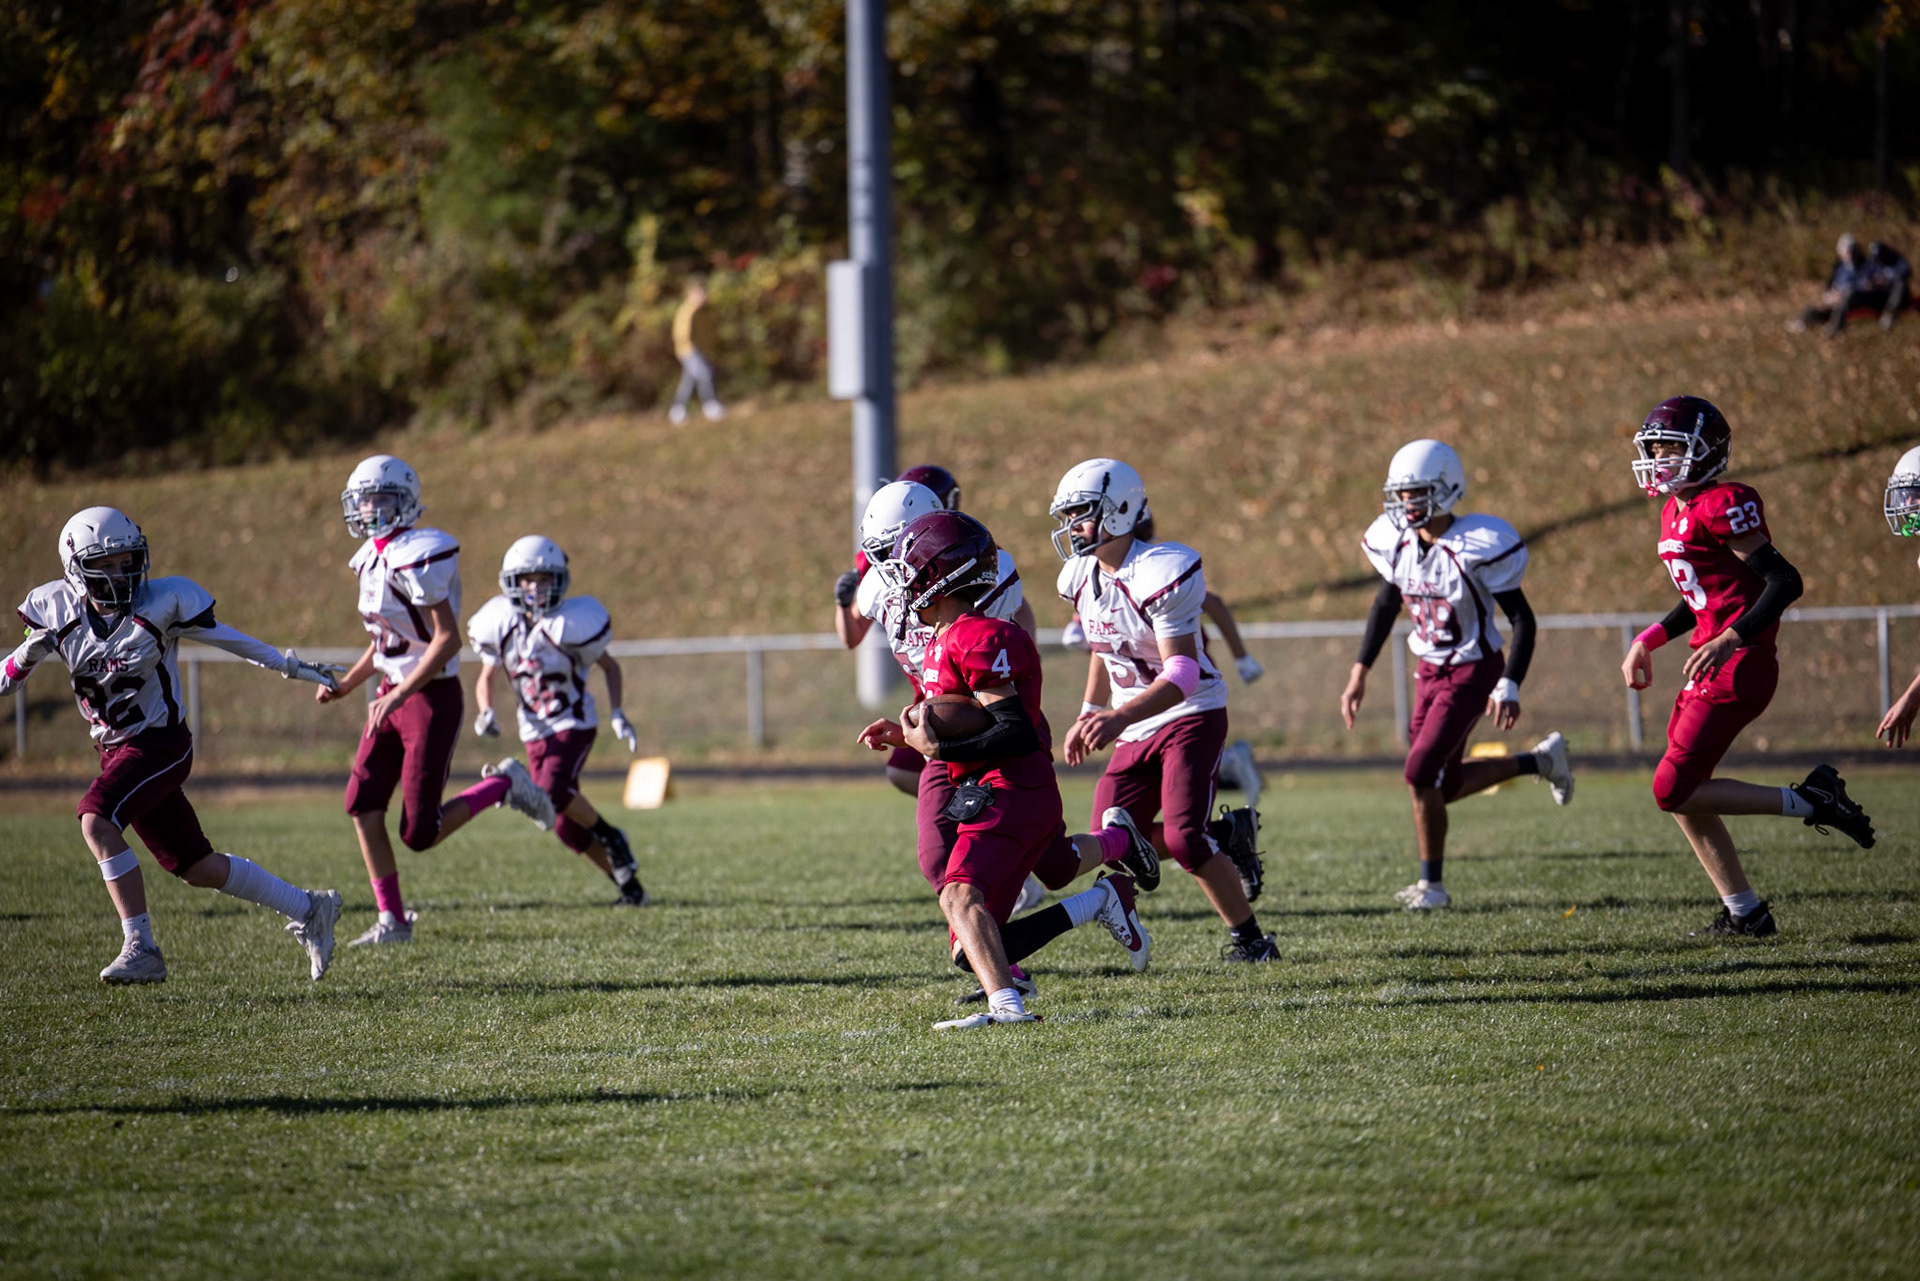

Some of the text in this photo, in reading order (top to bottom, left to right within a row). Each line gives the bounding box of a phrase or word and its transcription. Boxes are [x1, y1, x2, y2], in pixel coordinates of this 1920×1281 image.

[1726, 501, 1761, 534] 23
[1089, 619, 1118, 635] RAMS
[901, 631, 932, 647] AMS
[88, 658, 130, 673] RAMS
[991, 648, 1011, 679] 4
